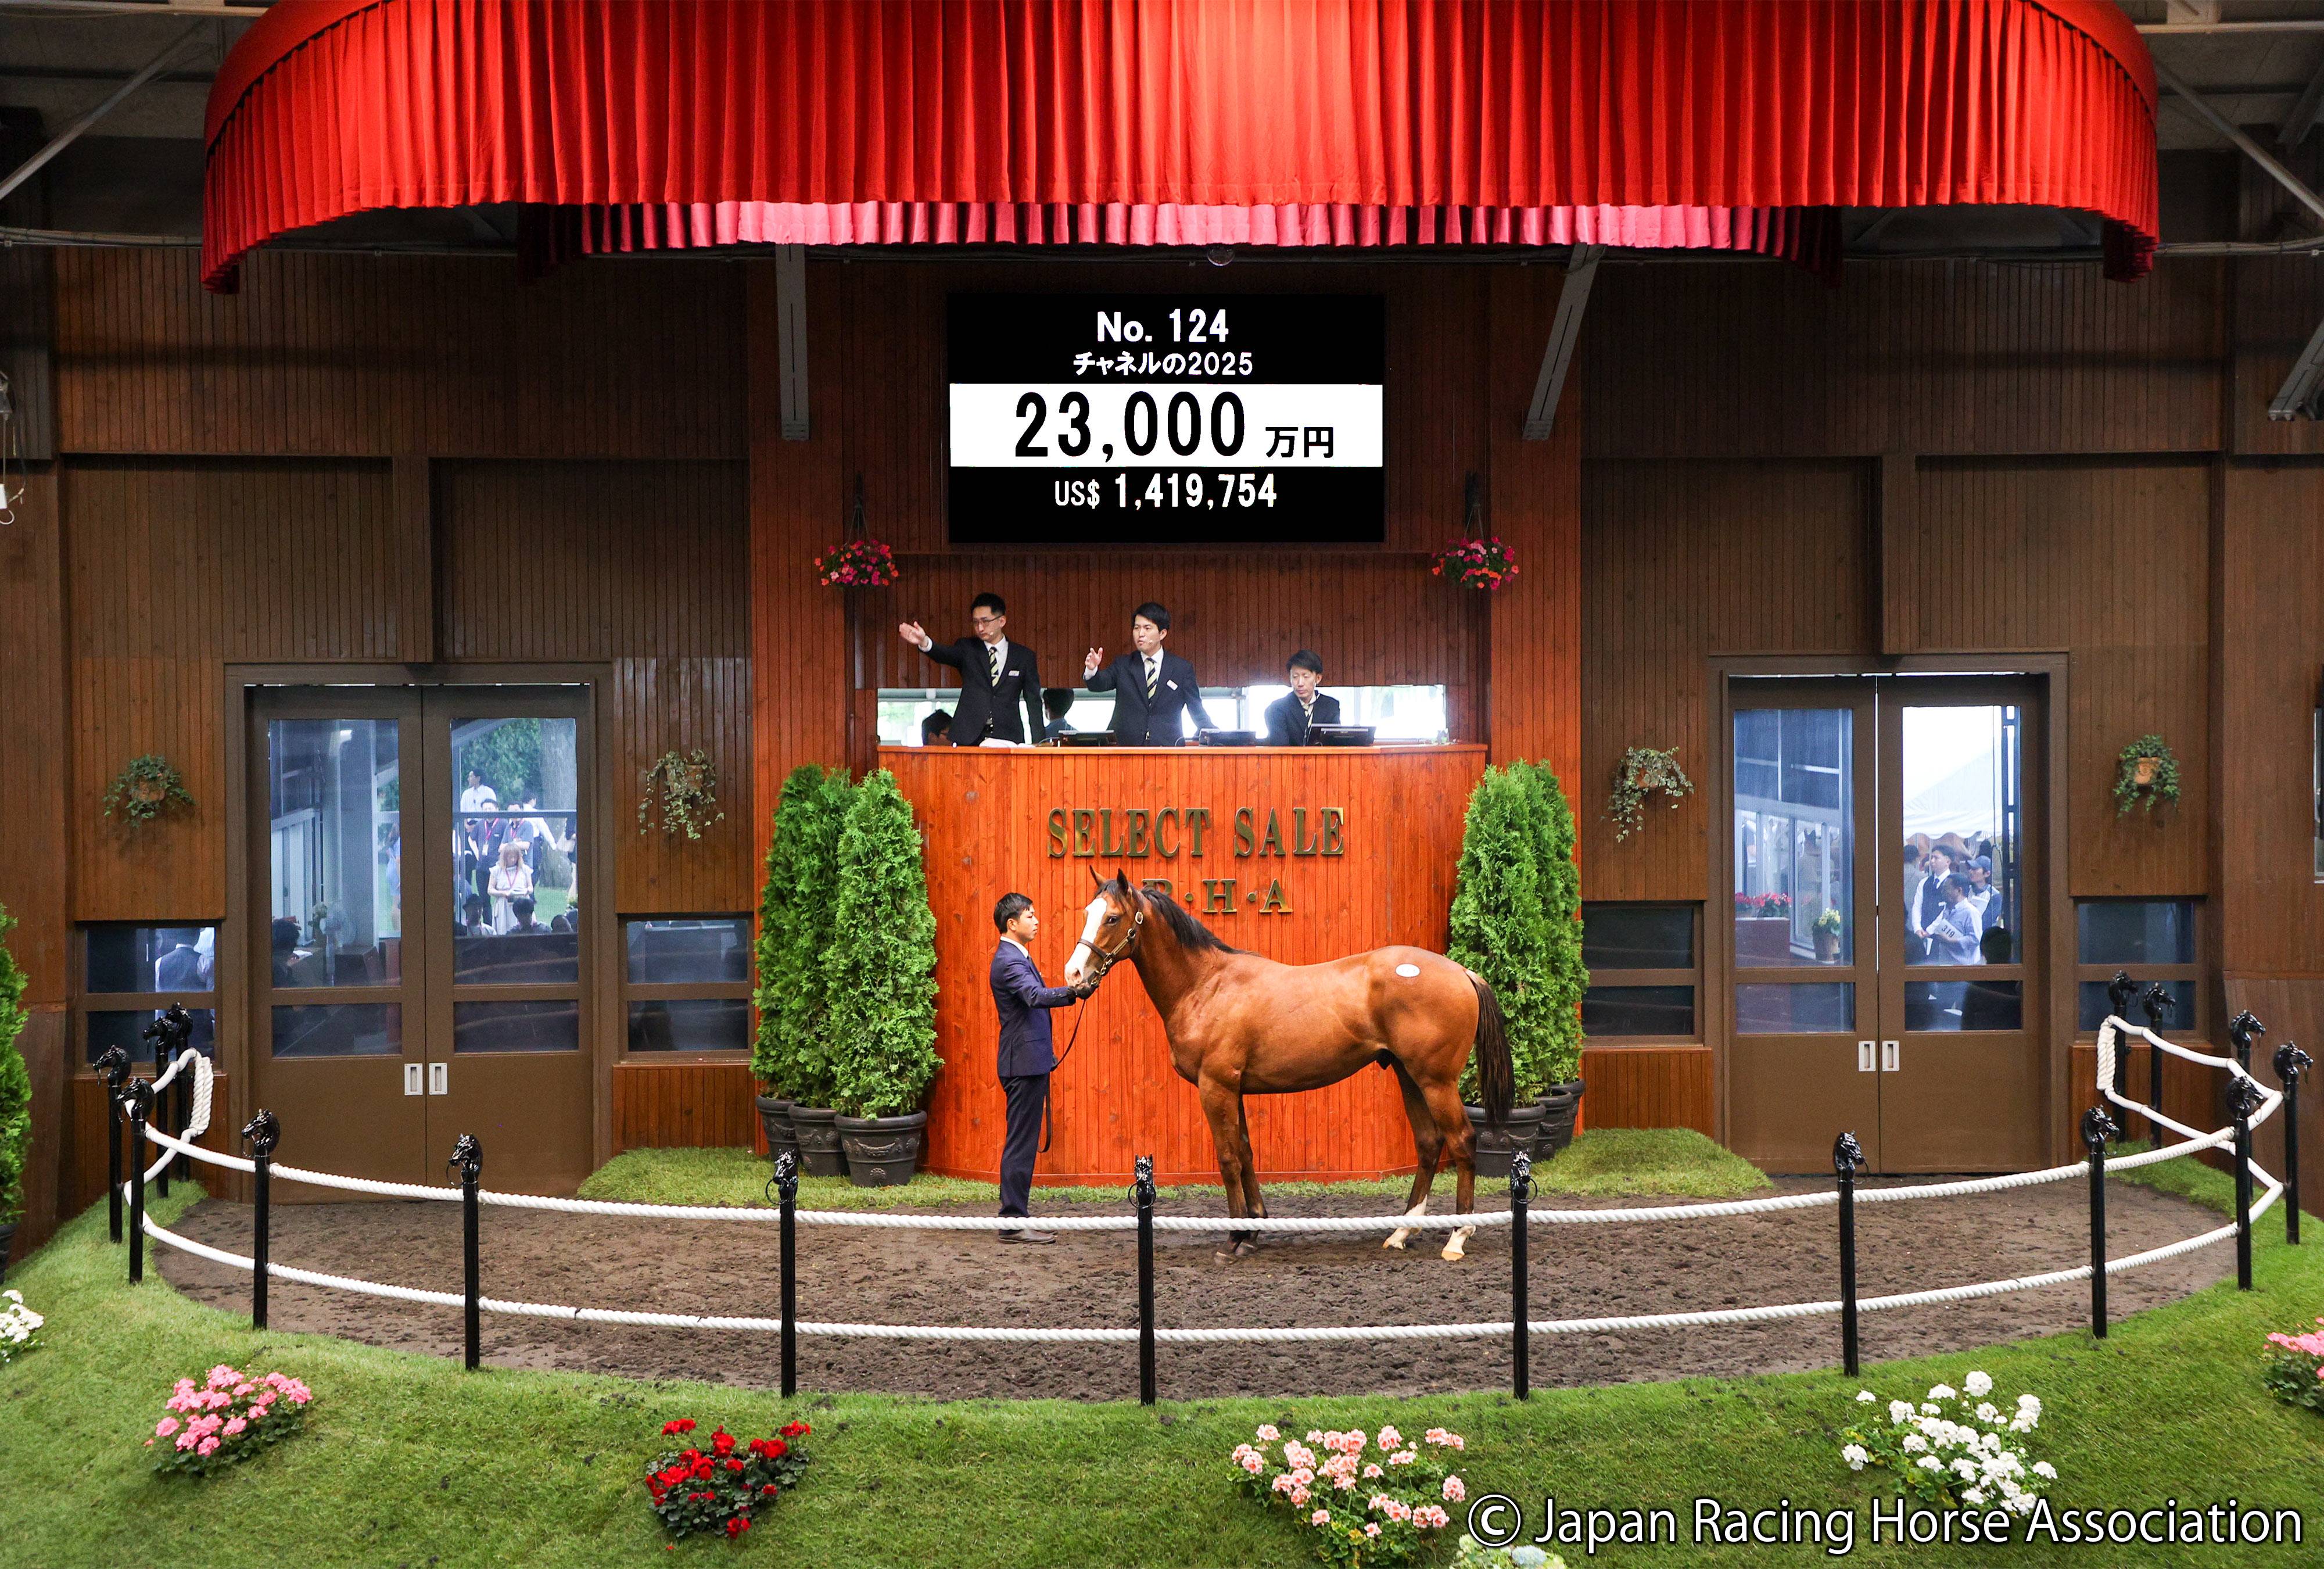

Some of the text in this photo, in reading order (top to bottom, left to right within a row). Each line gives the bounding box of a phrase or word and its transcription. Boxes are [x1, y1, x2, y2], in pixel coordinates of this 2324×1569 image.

[1097, 309, 1229, 342] No. 124
[1073, 350, 1253, 376] チャネルの2025
[1015, 391, 1334, 463] 23,000 万円
[1055, 473, 1277, 511] US$ 1,419,754
[1046, 807, 1344, 858] SELECT SALE
